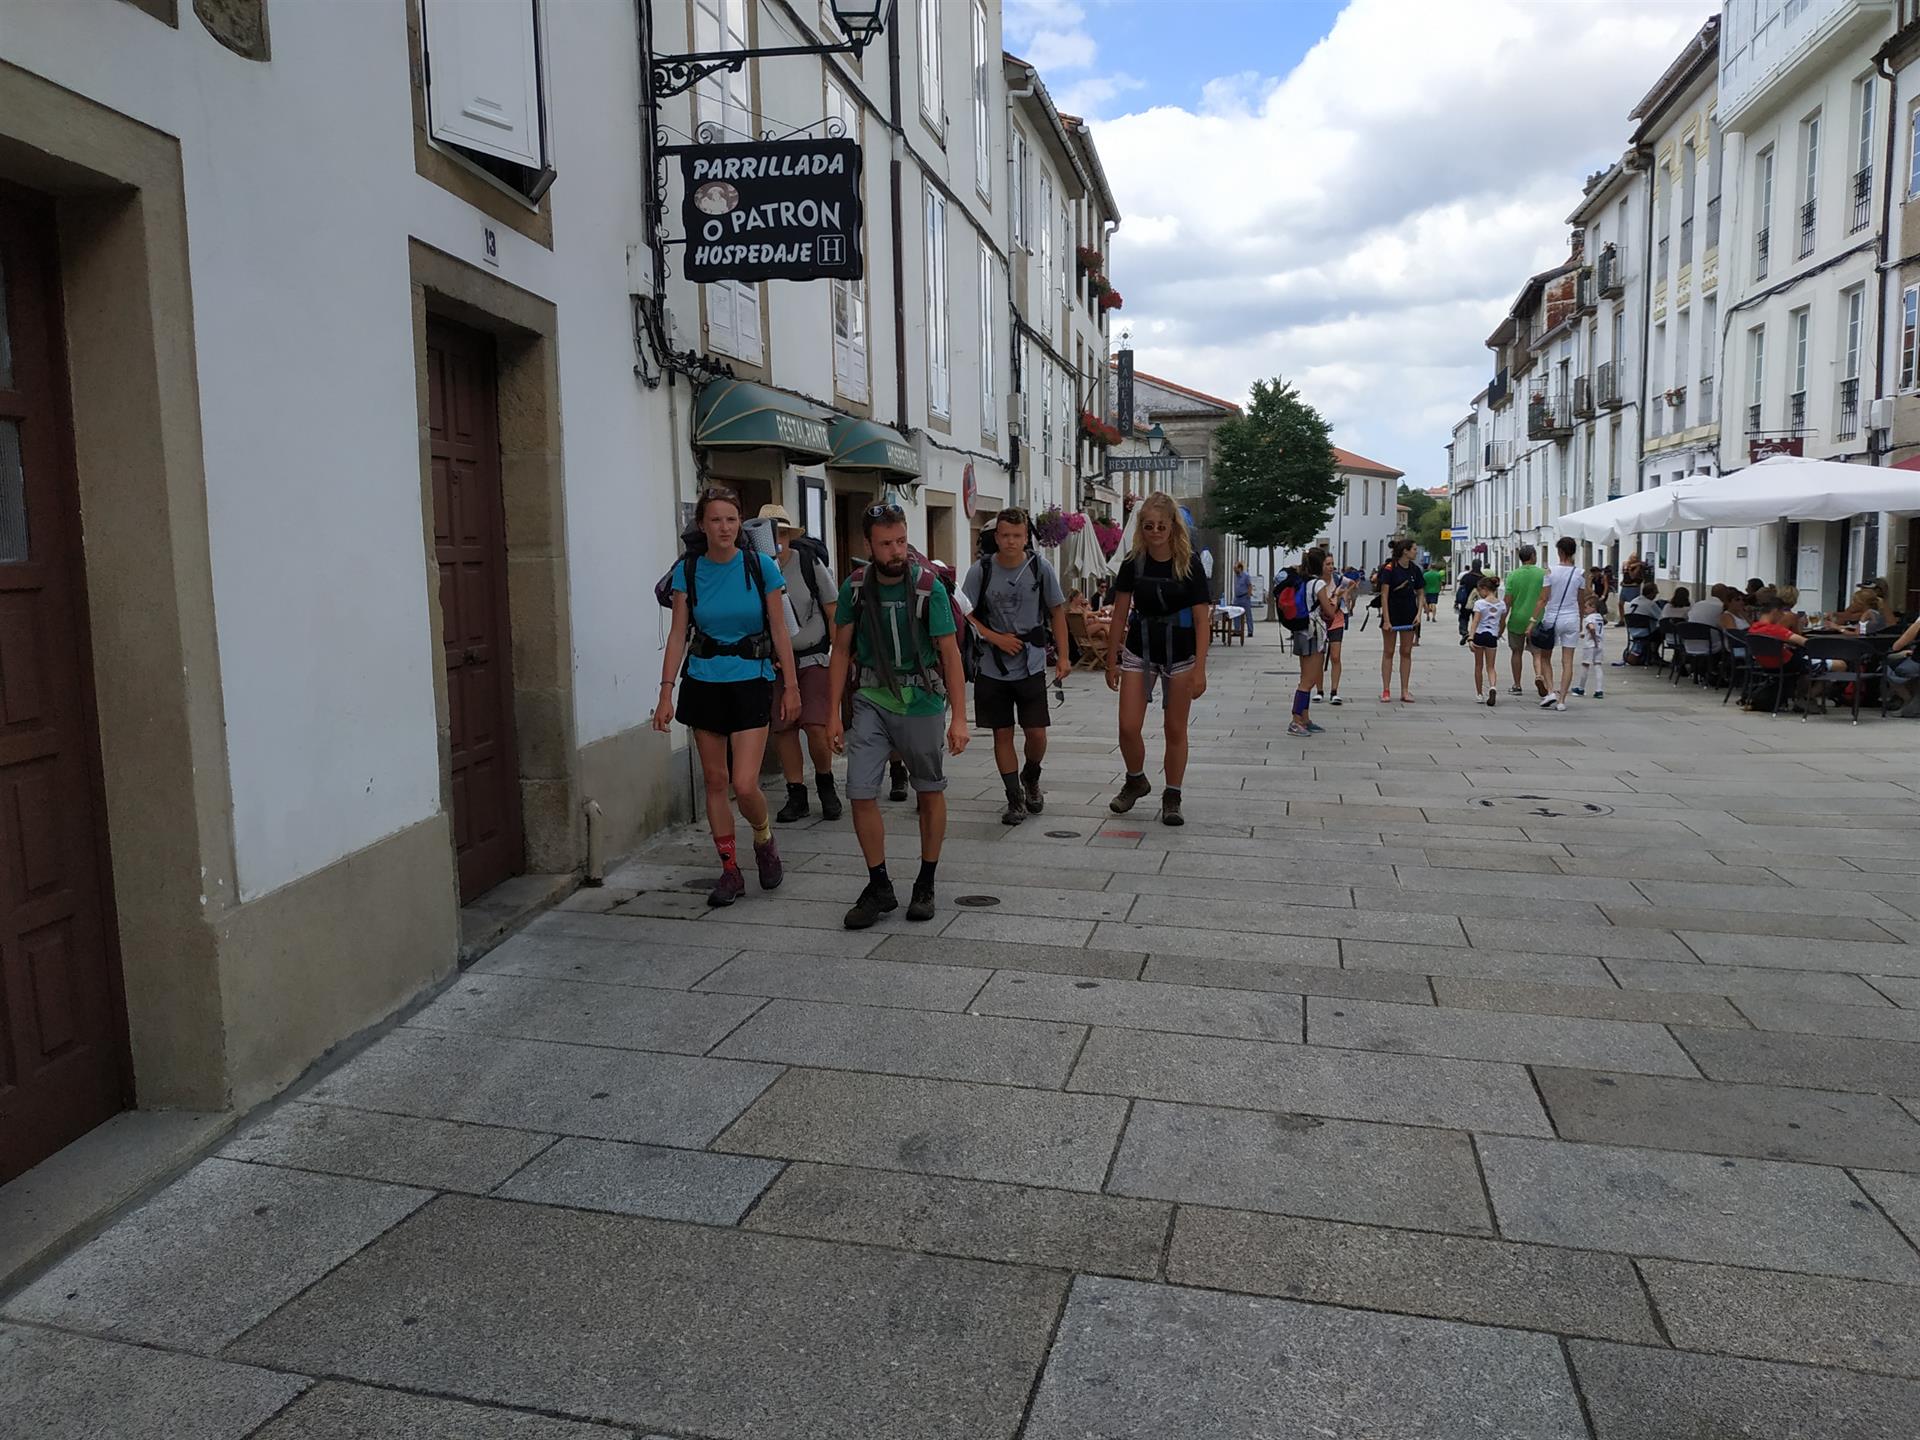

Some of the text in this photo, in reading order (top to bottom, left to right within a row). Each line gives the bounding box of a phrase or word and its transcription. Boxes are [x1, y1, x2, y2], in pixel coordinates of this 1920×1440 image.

[693, 153, 844, 180] PARRILLADA
[702, 199, 842, 241] O PATRON
[485, 228, 496, 257] 13
[694, 242, 813, 265] HOSPEDAJE
[821, 238, 843, 262] H
[1108, 458, 1177, 470] RESTAURANTE
